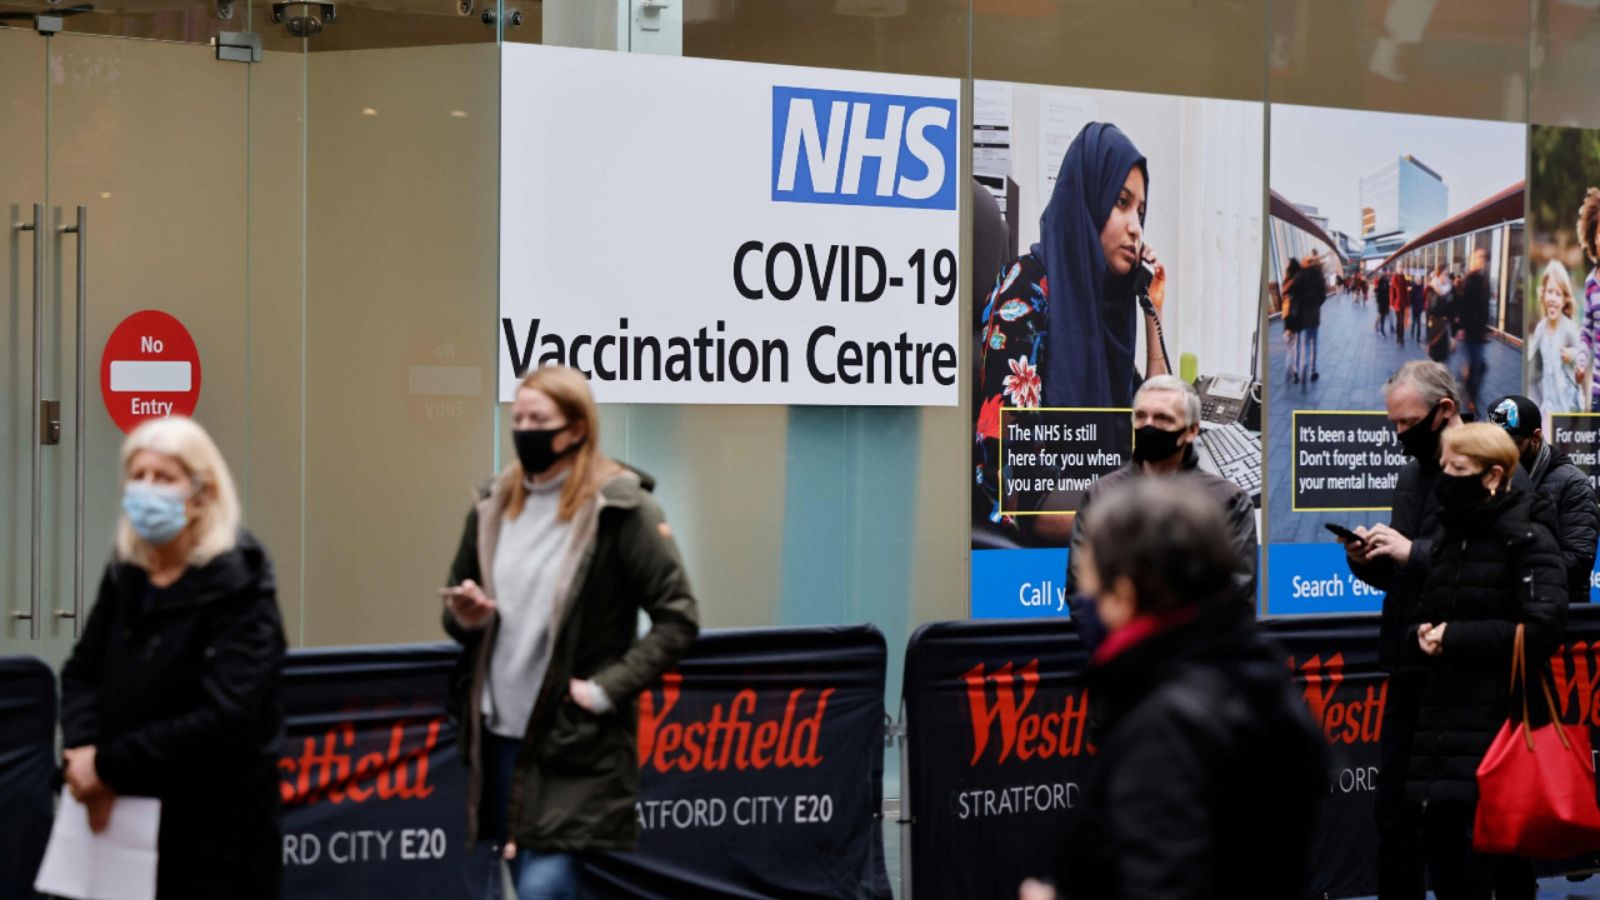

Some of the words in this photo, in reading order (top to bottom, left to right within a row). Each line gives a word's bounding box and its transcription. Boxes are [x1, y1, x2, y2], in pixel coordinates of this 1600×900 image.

[777, 98, 951, 199] NHS
[733, 240, 957, 305] COVID-19
[141, 335, 164, 353] No
[502, 317, 789, 383] Vaccination
[806, 326, 956, 385] Centre
[131, 397, 173, 418] Entry
[1007, 424, 1031, 441] The
[1034, 425, 1060, 441] NHS
[1063, 424, 1073, 441] is
[1075, 424, 1097, 441] still
[1300, 426, 1315, 442] It's
[1318, 426, 1345, 442] been
[1347, 430, 1355, 442] a
[1357, 426, 1390, 446] tough
[1556, 427, 1572, 443] For
[1574, 431, 1597, 443] over
[1008, 449, 1036, 466] here
[1039, 449, 1058, 466] for
[1061, 453, 1084, 471] you
[1087, 449, 1121, 466] when
[1299, 449, 1330, 466] Don't
[1333, 449, 1367, 470] forget
[1369, 452, 1382, 466] to
[1384, 449, 1407, 466] look
[1007, 478, 1031, 496] you
[1034, 478, 1054, 491] are
[1299, 477, 1325, 494] your
[1327, 473, 1365, 489] mental
[1020, 581, 1051, 606] Call
[1292, 573, 1344, 598] Search
[277, 717, 441, 804] stfield
[634, 798, 727, 829] ATFORD
[733, 796, 788, 825] CITY
[794, 794, 833, 823] E20
[958, 782, 1080, 820] STRATFORD
[328, 830, 394, 864] CITY
[401, 828, 447, 860] E20
